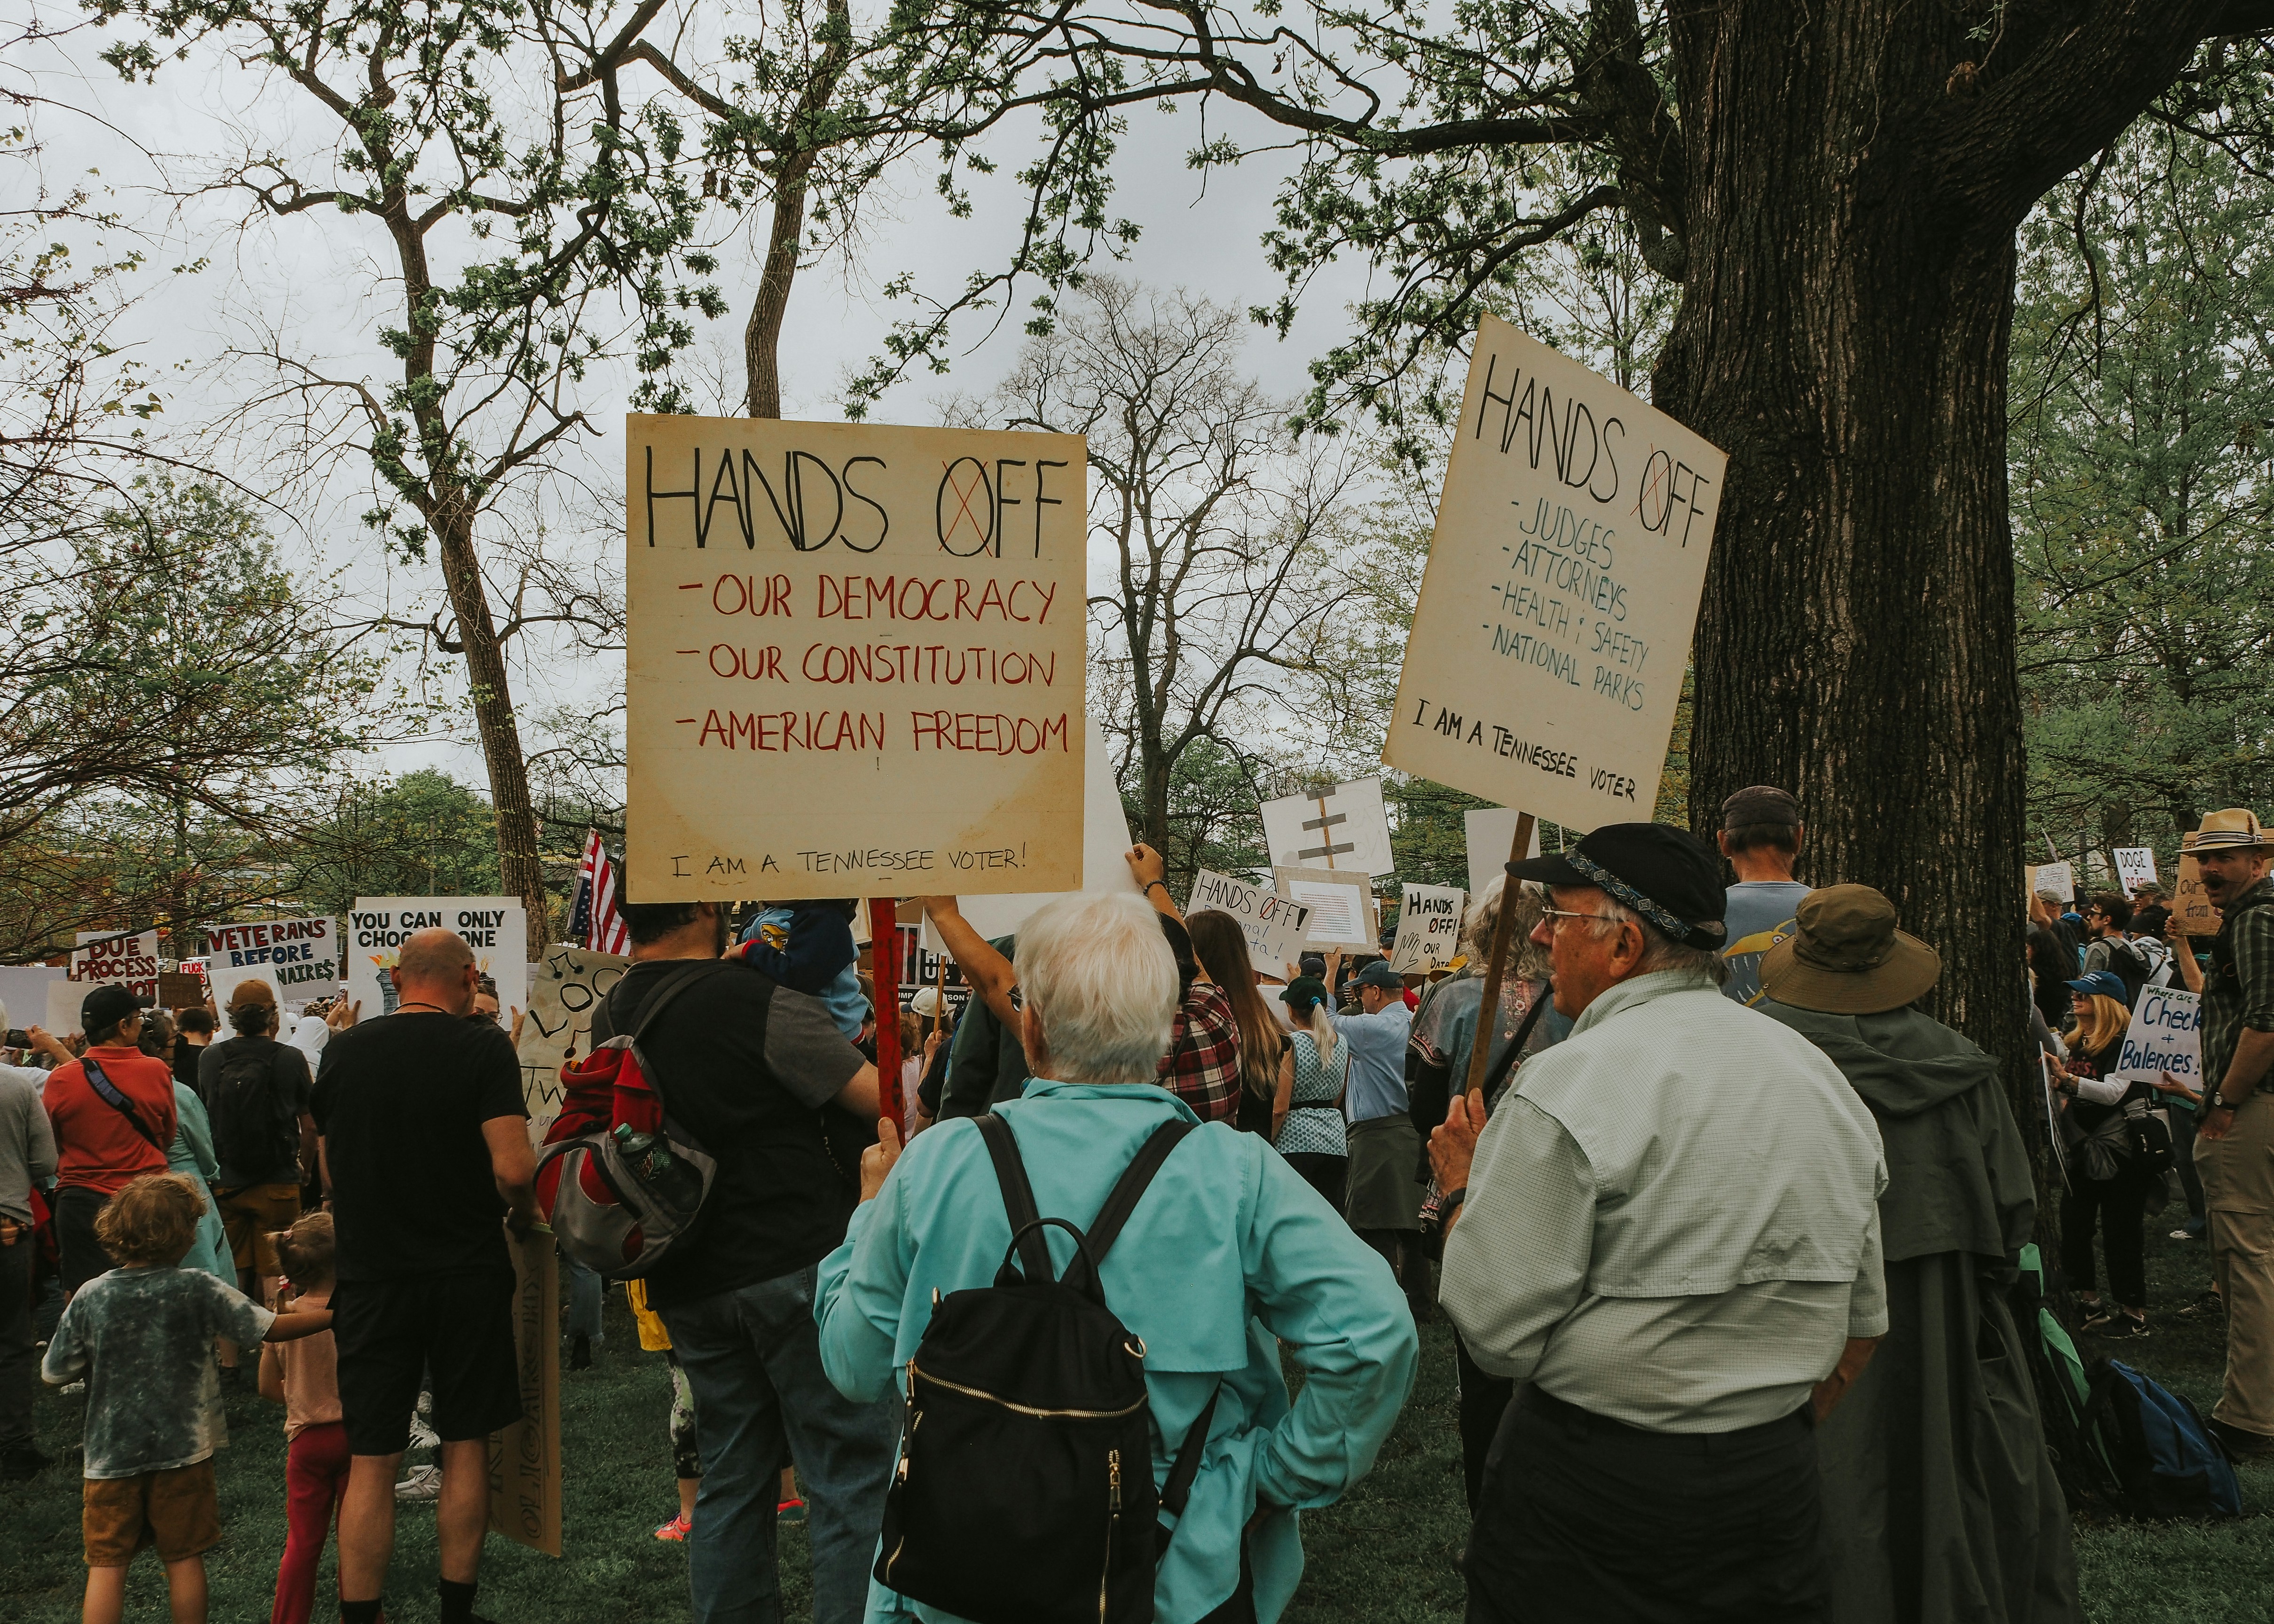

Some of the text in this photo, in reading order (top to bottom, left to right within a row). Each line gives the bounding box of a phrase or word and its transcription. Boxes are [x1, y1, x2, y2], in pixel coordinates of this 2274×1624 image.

[1476, 354, 1709, 548] HANDS OFF
[646, 445, 1068, 558] HANDS OFF
[818, 574, 1056, 624] DEMOCRACY
[1591, 622, 1648, 672] SAFETY
[802, 643, 1054, 686] CONSTITUTION
[1594, 666, 1644, 710] PARKS
[911, 710, 1068, 756] FREEDOM
[1412, 698, 1635, 803] I AM A TENNESSEE VOTER
[671, 842, 1026, 877] I AM A TENNESSEE VOTER!
[2120, 851, 2146, 868] DOGE
[1197, 875, 1256, 914] HANDS
[1408, 892, 1454, 916] HANDS
[208, 919, 327, 952] VETERANS
[351, 910, 506, 929] YOU CAN ONLY
[88, 937, 141, 959] DUE
[230, 943, 313, 967] BEFORE
[458, 930, 496, 947] ONE
[1424, 943, 1440, 954] OUR
[78, 956, 156, 982] PROCESS
[182, 961, 204, 973] FUCK
[2147, 987, 2174, 999] Where
[2176, 994, 2192, 1004] are
